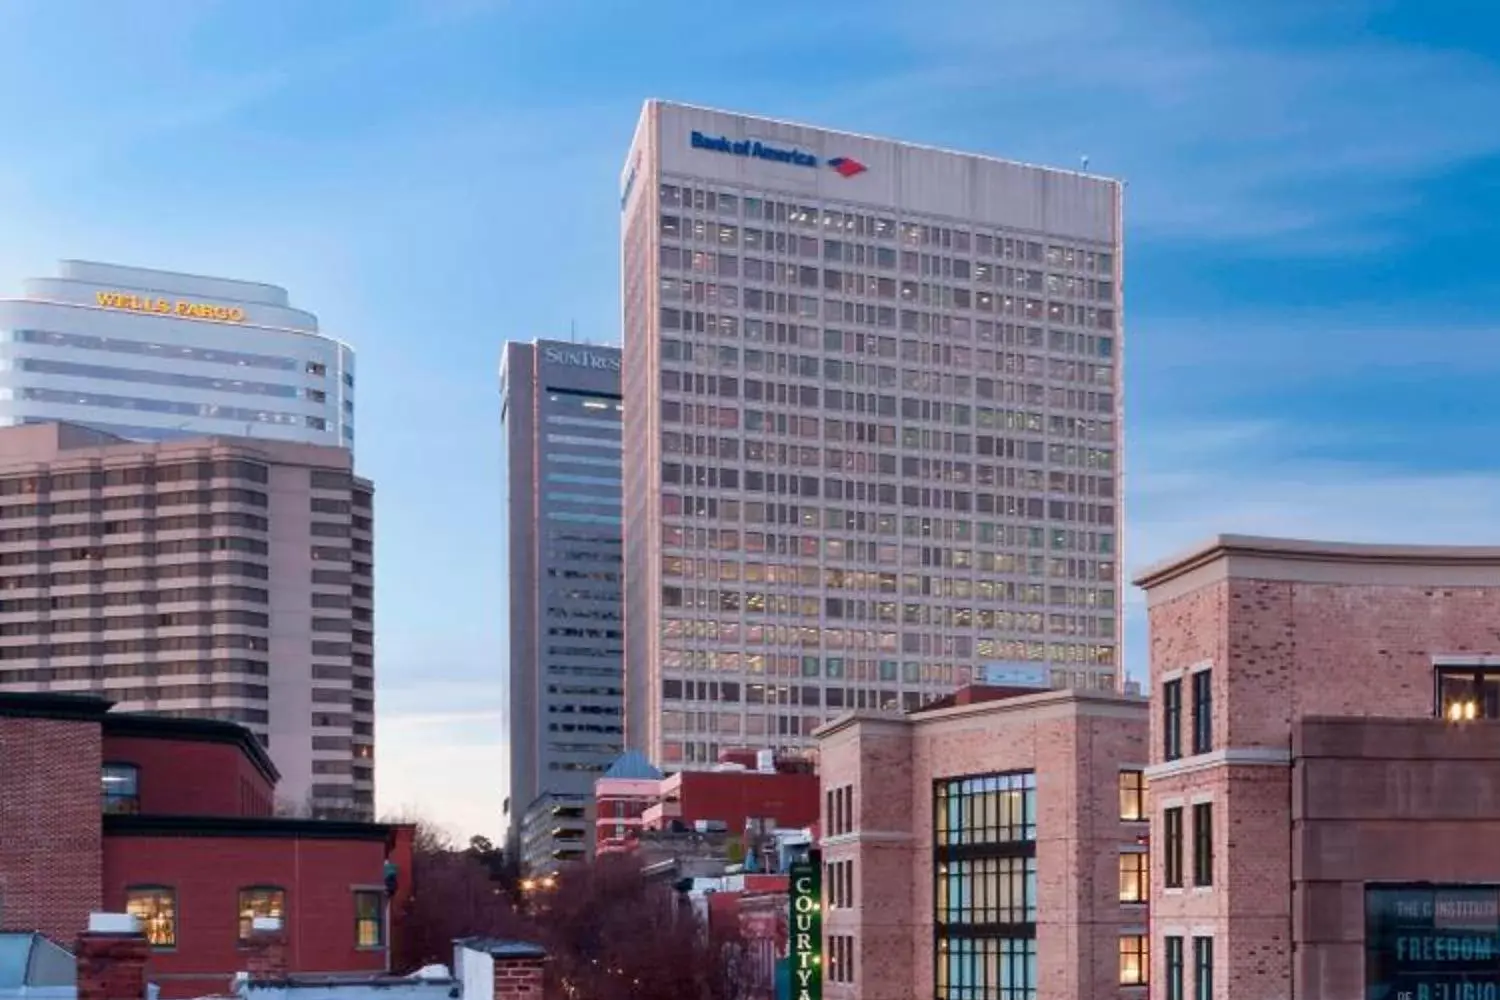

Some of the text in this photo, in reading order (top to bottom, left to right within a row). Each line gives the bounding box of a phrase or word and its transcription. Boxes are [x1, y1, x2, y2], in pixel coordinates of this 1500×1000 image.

[691, 130, 817, 167] Bank of America
[96, 291, 245, 321] WELLS FARGO
[545, 347, 620, 371] SUNTRUS
[1396, 936, 1492, 961] FREEDOM
